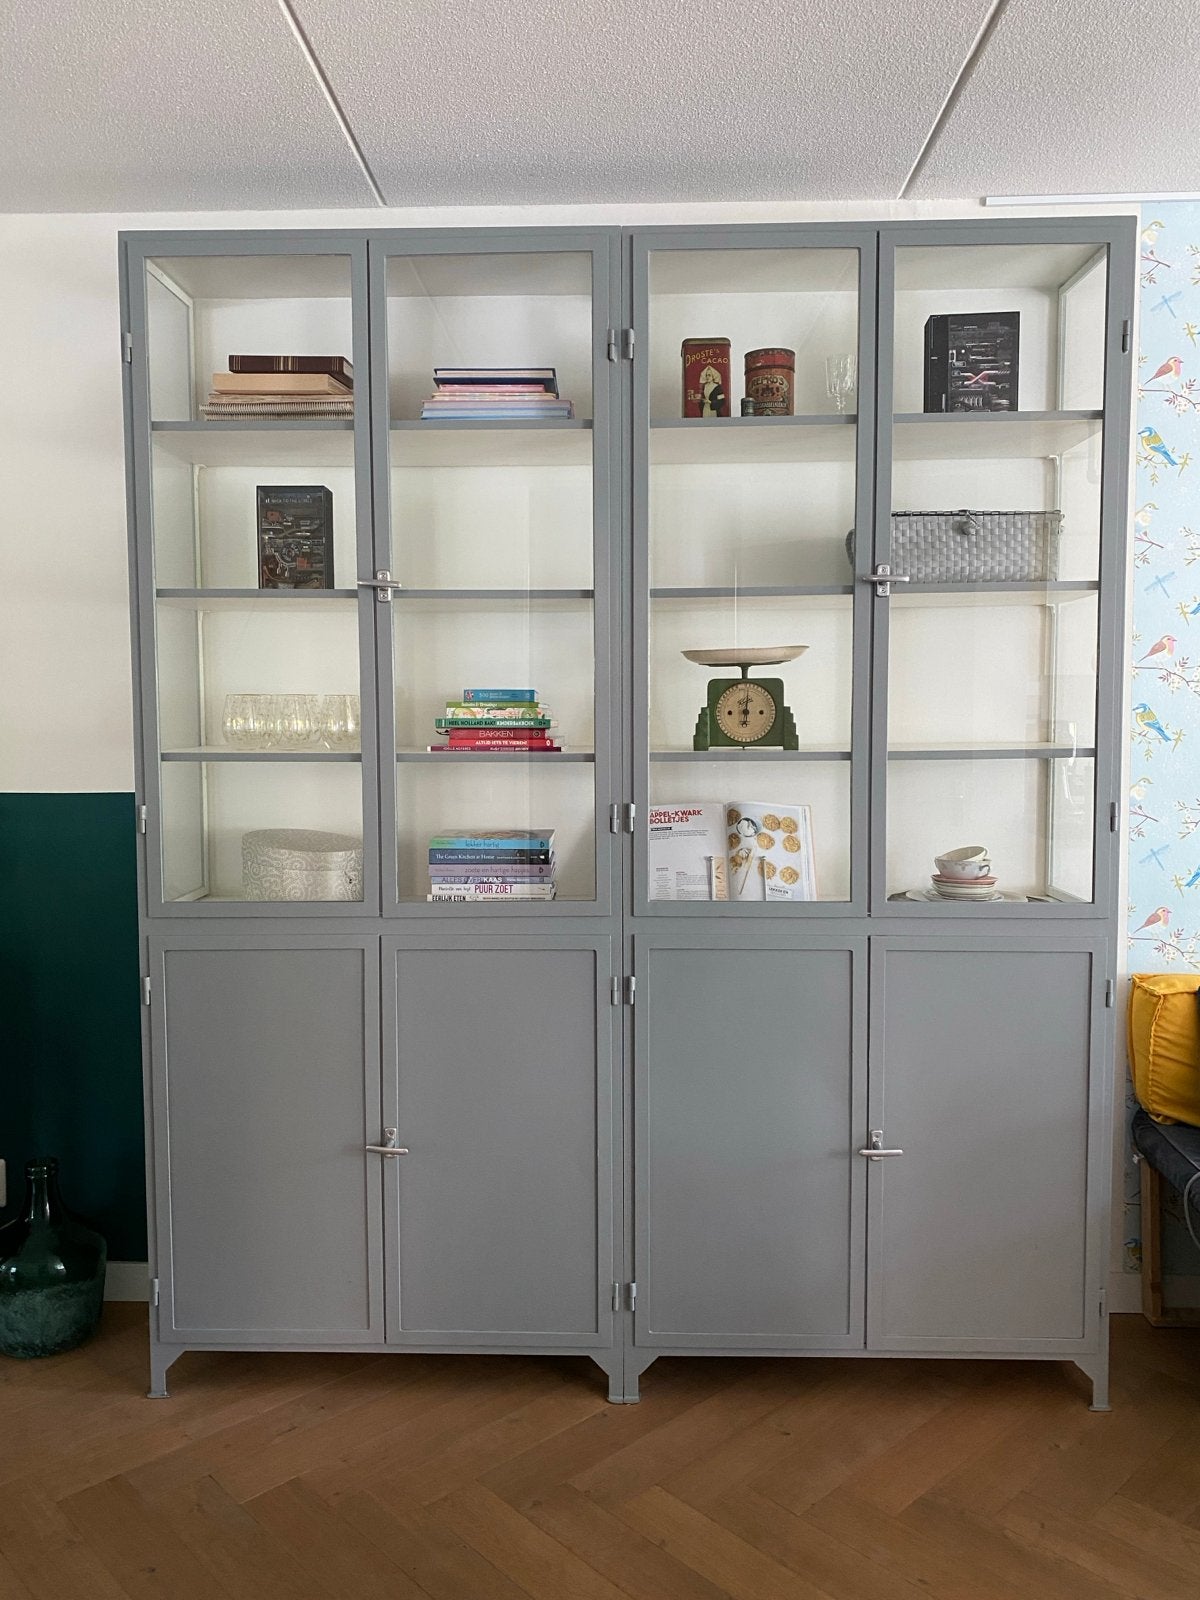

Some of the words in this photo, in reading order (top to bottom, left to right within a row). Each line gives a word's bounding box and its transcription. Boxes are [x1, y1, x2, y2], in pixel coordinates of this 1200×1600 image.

[701, 356, 729, 364] CACAO
[479, 730, 514, 738] BAKKEN
[649, 816, 690, 824] BOLLETJES
[474, 884, 493, 894] PUUR
[494, 884, 514, 894] ZOET
[453, 894, 466, 902] ETEN
